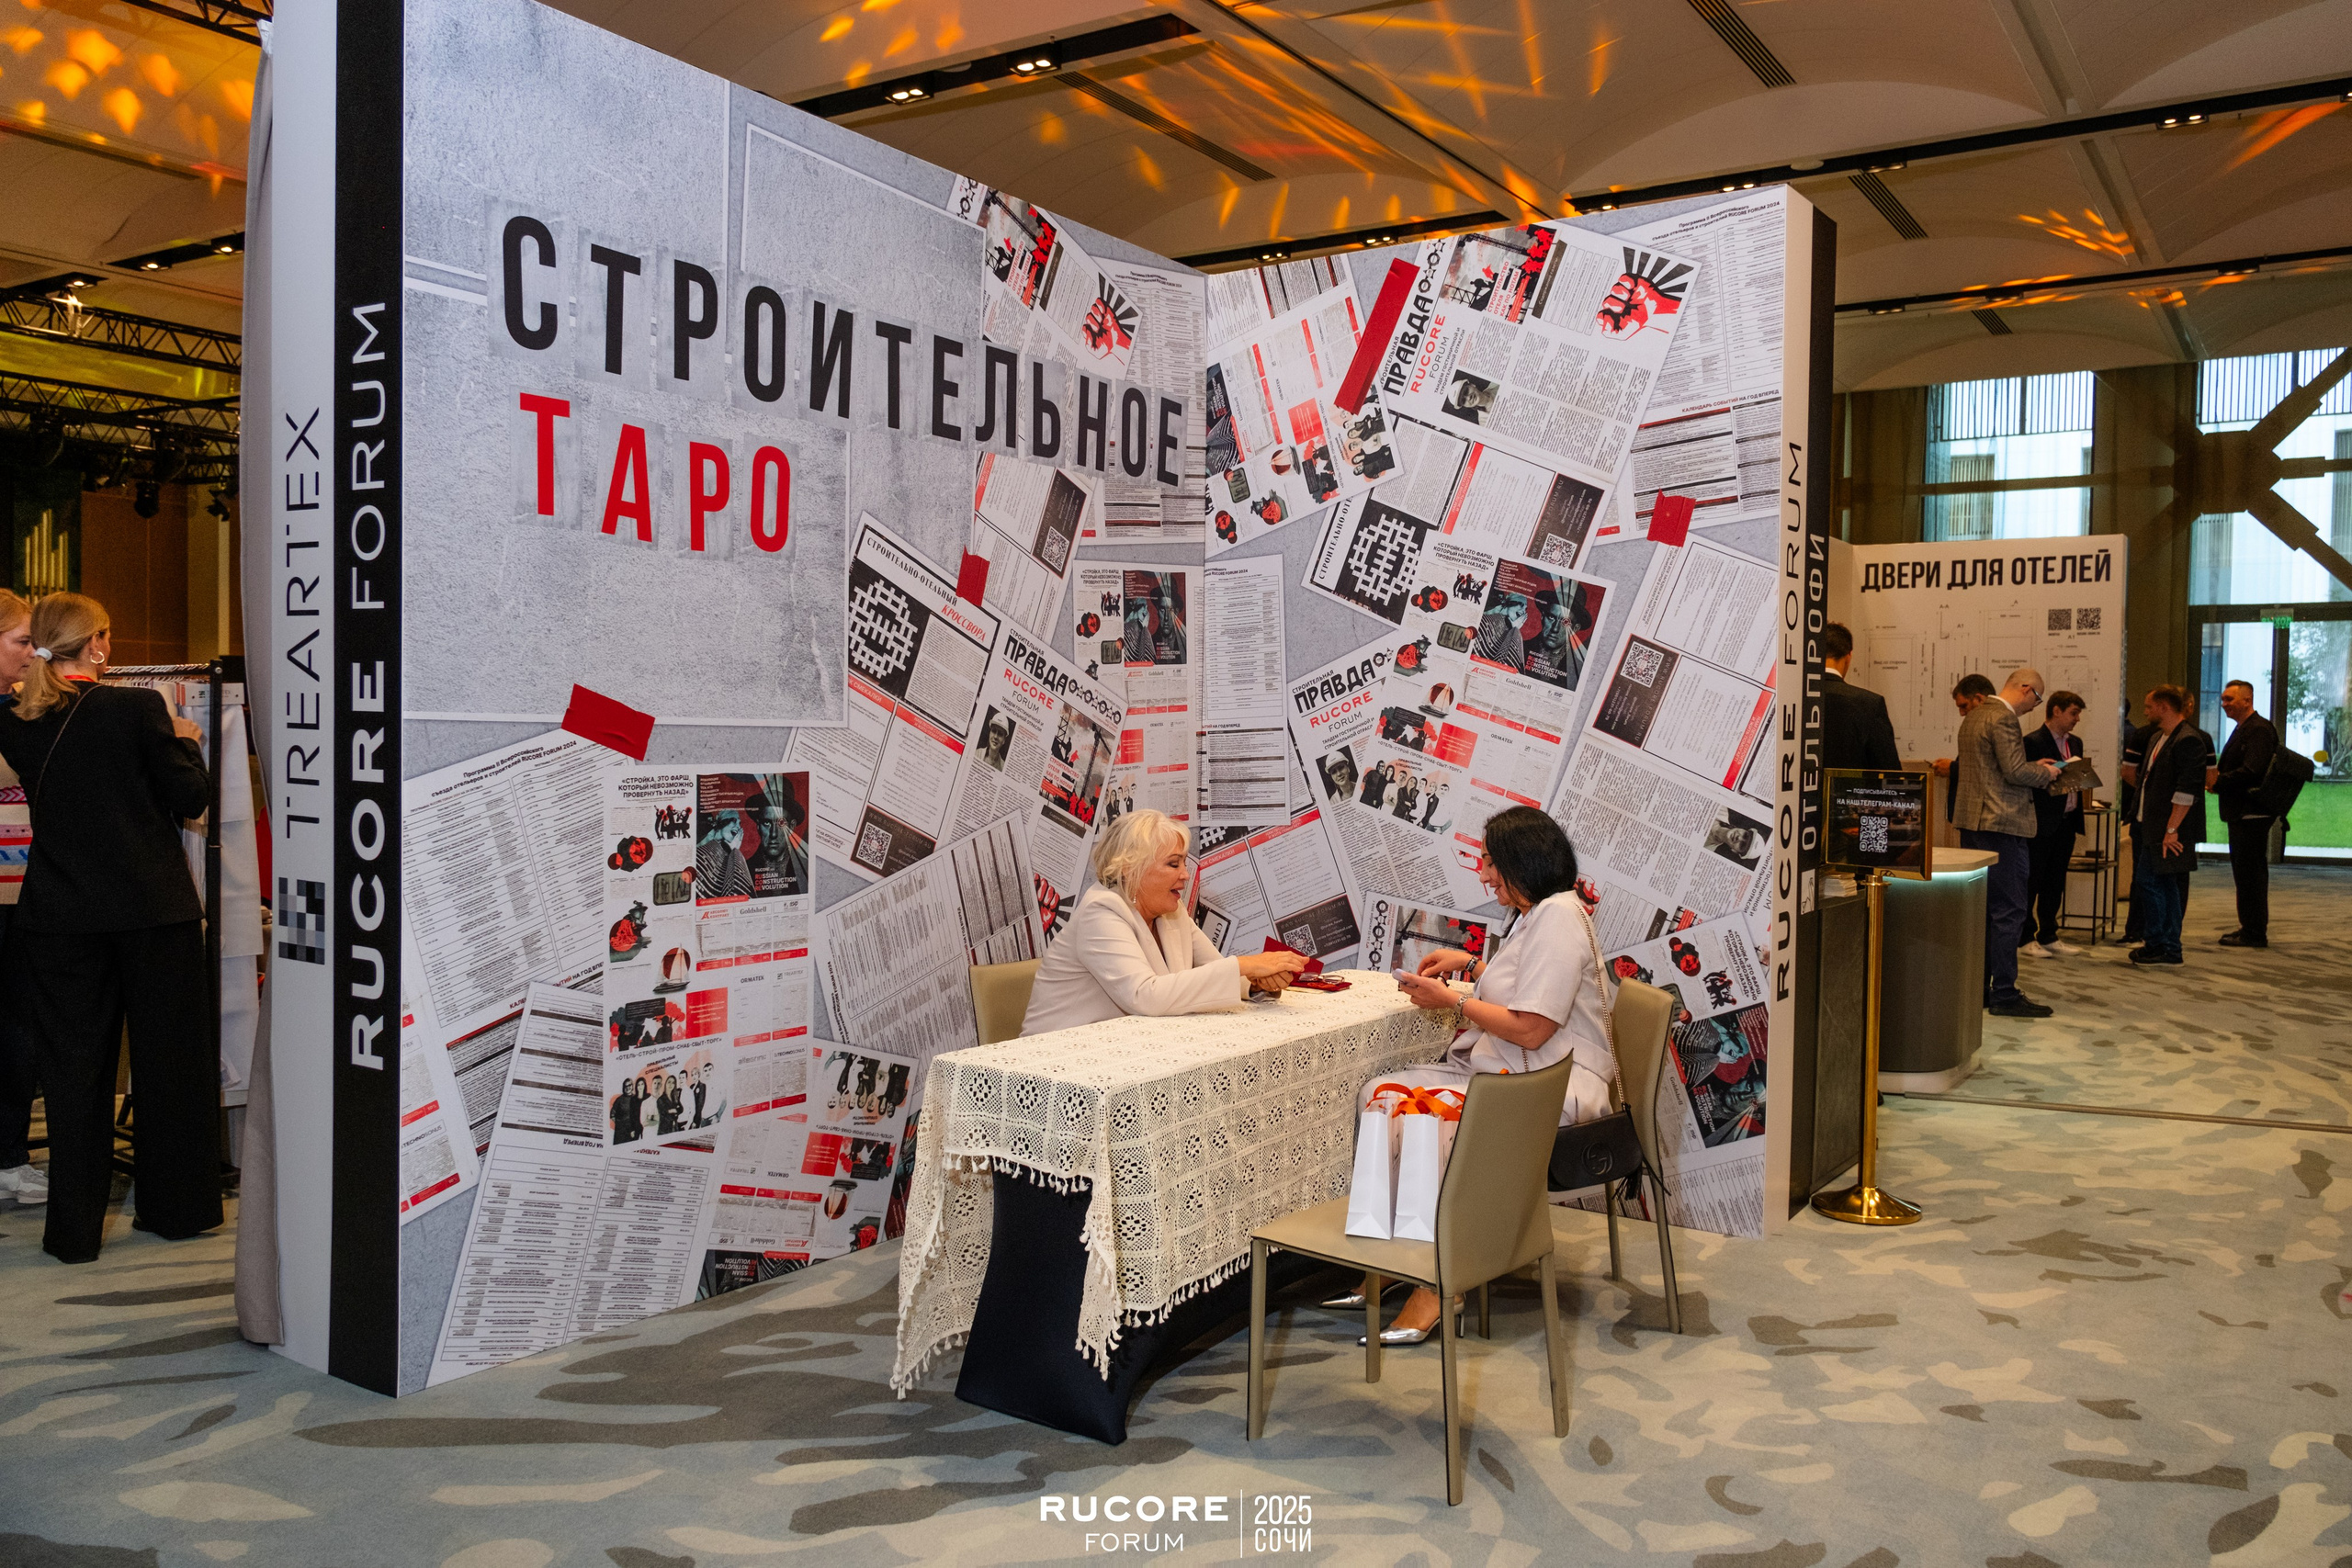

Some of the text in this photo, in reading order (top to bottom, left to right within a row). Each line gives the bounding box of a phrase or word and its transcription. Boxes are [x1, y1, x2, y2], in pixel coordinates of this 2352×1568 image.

[1679, 218, 1706, 228] Программа
[1747, 206, 1766, 214] FORUM
[1487, 261, 1510, 312] СТРОИТЕЛЬСТВО
[1504, 293, 1511, 304] ПО
[1509, 271, 1519, 294] НОТАМ
[1494, 294, 1504, 314] ОТЕЛЯ
[502, 215, 1182, 487] СТРОИТЕЛЬНОЕ
[1383, 294, 1433, 396] ПРАВДА
[1410, 314, 1445, 393] RUCORE
[1429, 336, 1450, 379] FORUM
[1434, 333, 1458, 393] ТАНДЕМ ГОСТИНИЧНОЙ
[1439, 329, 1465, 395] СТРОИТЕЛЬНОЙ ОТРАСЛИ
[1681, 402, 1713, 413] КАЛЕНДАРЬ
[1747, 392, 1758, 400] ГОД
[1758, 389, 1780, 398] ВПЕРЕД
[520, 392, 791, 553] ТАРО
[1433, 546, 1495, 567] КОТОРЫЙ НЕВОЗМОЖНО
[1435, 552, 1488, 570] ПРОВЕРНУТЬ НАЗАД»
[1437, 542, 1464, 553] «СТРОЙКА,
[866, 536, 958, 607] СТРОИТЕЛЬНО-ОТЕЛЬНЫЙ
[1860, 548, 2110, 592] ДВЕРИ ДЛЯ ОТЕЛЕЙ
[286, 407, 320, 838] TREARTEX
[941, 604, 985, 643] КРОССВОРД
[1010, 628, 1045, 656] СТРОИТЕЛЬНАЯ
[1003, 634, 1069, 696] ПРАВДА
[1525, 665, 1558, 680] REVOLUTION
[1526, 660, 1567, 677] CONSTRUCTION
[1527, 655, 1550, 667] RUSSIAN
[351, 302, 386, 1070] RUCORE FORUM
[1003, 668, 1054, 710] RUCORE
[1292, 670, 1334, 694] СТРОИТЕЛЬНАЯ
[1294, 659, 1376, 714] ПРАВДА
[1505, 677, 1532, 691] Goldshell
[1012, 690, 1040, 714] FORUM
[1309, 691, 1374, 728] RUCORE
[1322, 718, 1372, 745] ТАНДЕМ ГОСТИНИЧНОЙ
[1328, 711, 1363, 733] FORUM
[1777, 442, 1802, 1002] RUCORE FORUM
[521, 753, 542, 762] RUCORE
[542, 746, 562, 759] FORUM
[563, 740, 577, 750] 2024
[1324, 732, 1357, 750] СТРОИТЕЛЬНОЙ
[463, 763, 496, 779] Программа
[618, 782, 694, 791] КОТОРЫЙ НЕВОЗМОЖНО
[1852, 788, 1898, 796] ПОДПИСЫВАЙТЕСЬ
[1860, 799, 1916, 808] ТЕЛЕГРАМ-КАНАЛ
[740, 906, 767, 915] Goldshell
[1744, 887, 1756, 913] ОТРАСЛИ
[1724, 935, 1740, 974] ПРОВЕРНУТЬ
[1727, 929, 1758, 1001] КОТОРЫЙ НЕВОЗМОЖНО
[741, 975, 764, 984] ORMATEK
[1747, 964, 1755, 976] ЭТО
[1669, 1077, 1684, 1106] Goldshell
[1692, 1088, 1708, 1124] REVOLUTION
[1697, 1087, 1716, 1133] CONSTRUCTION
